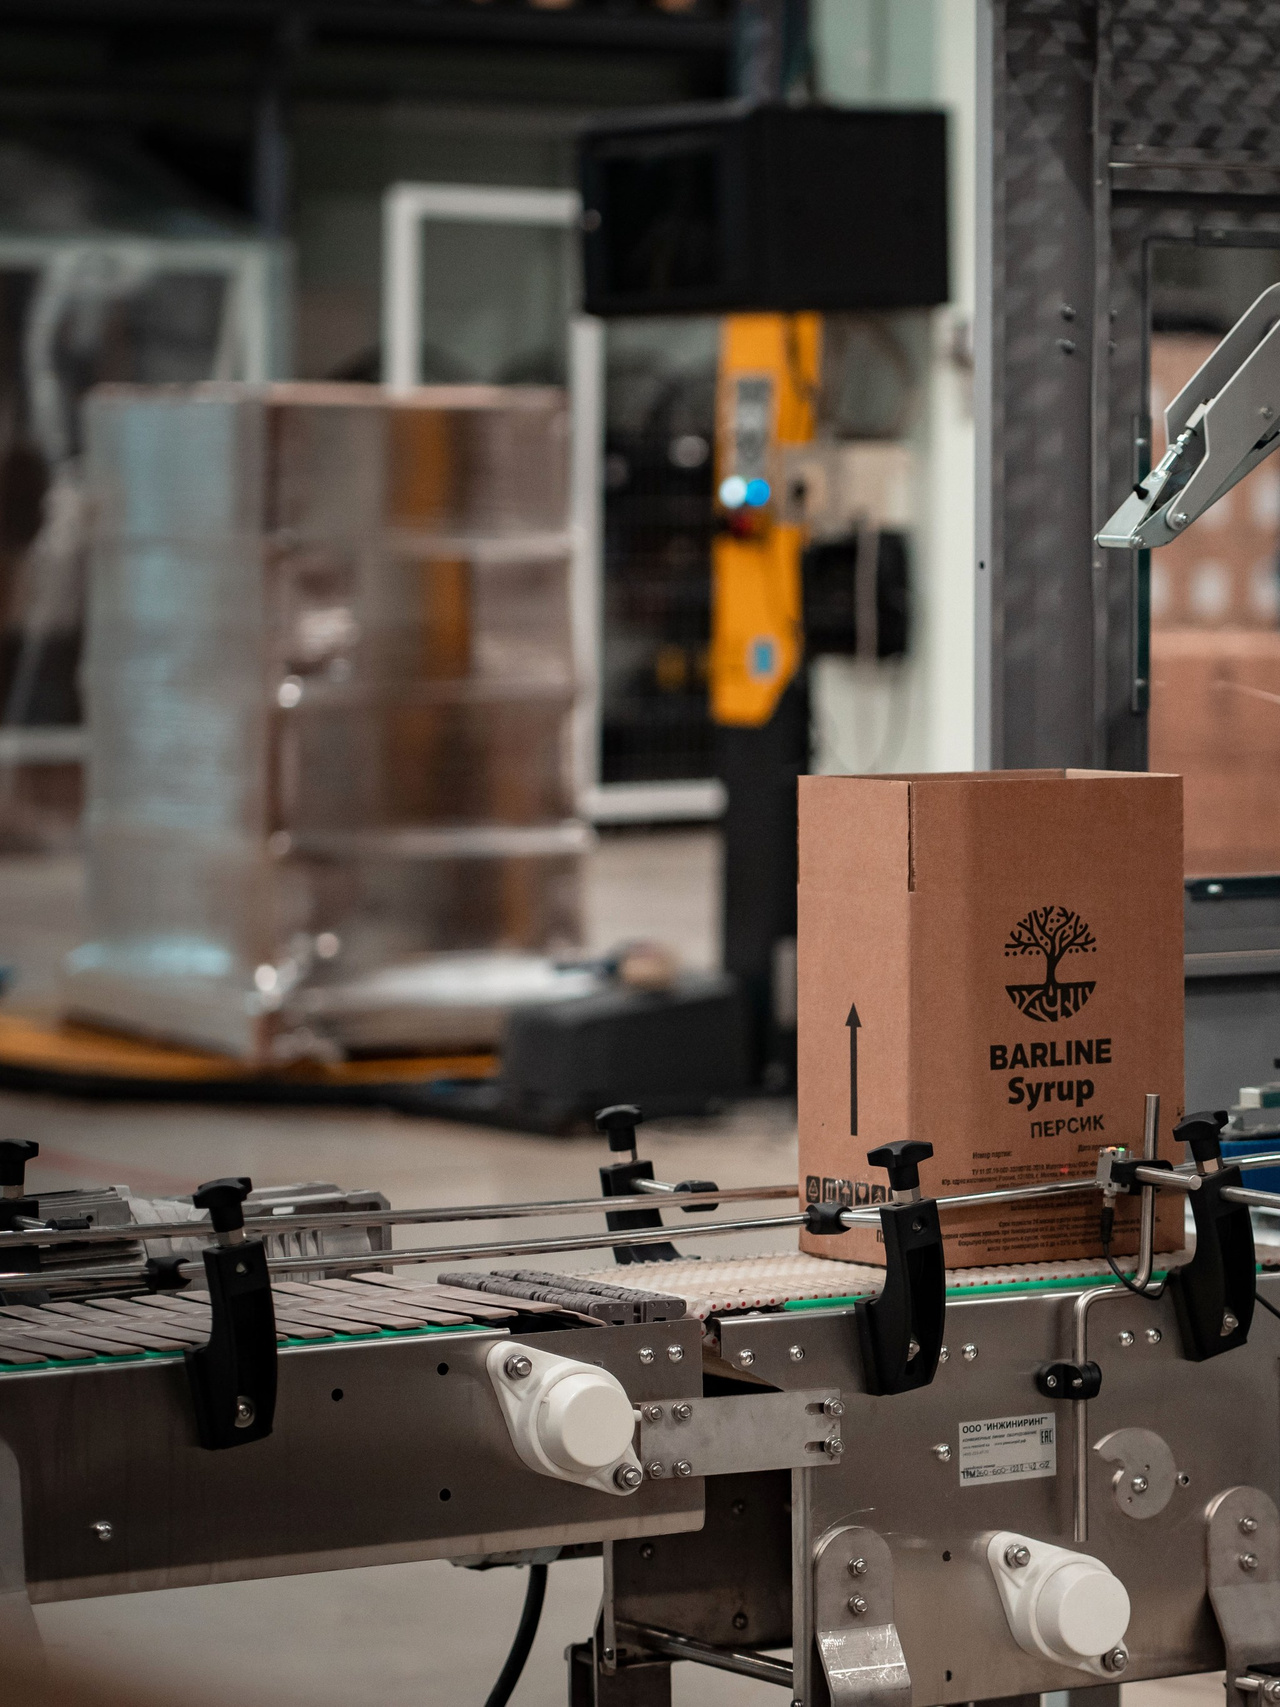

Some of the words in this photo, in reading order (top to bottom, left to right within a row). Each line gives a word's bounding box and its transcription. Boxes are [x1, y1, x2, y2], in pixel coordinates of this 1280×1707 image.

[990, 1038, 1112, 1070] BARLINE
[1008, 1077, 1095, 1112] Syrup
[1031, 1114, 1105, 1139] ПЕРСИК
[962, 1424, 982, 1434] ООО
[984, 1417, 1048, 1431] "ИНЖИНИРИНГ"
